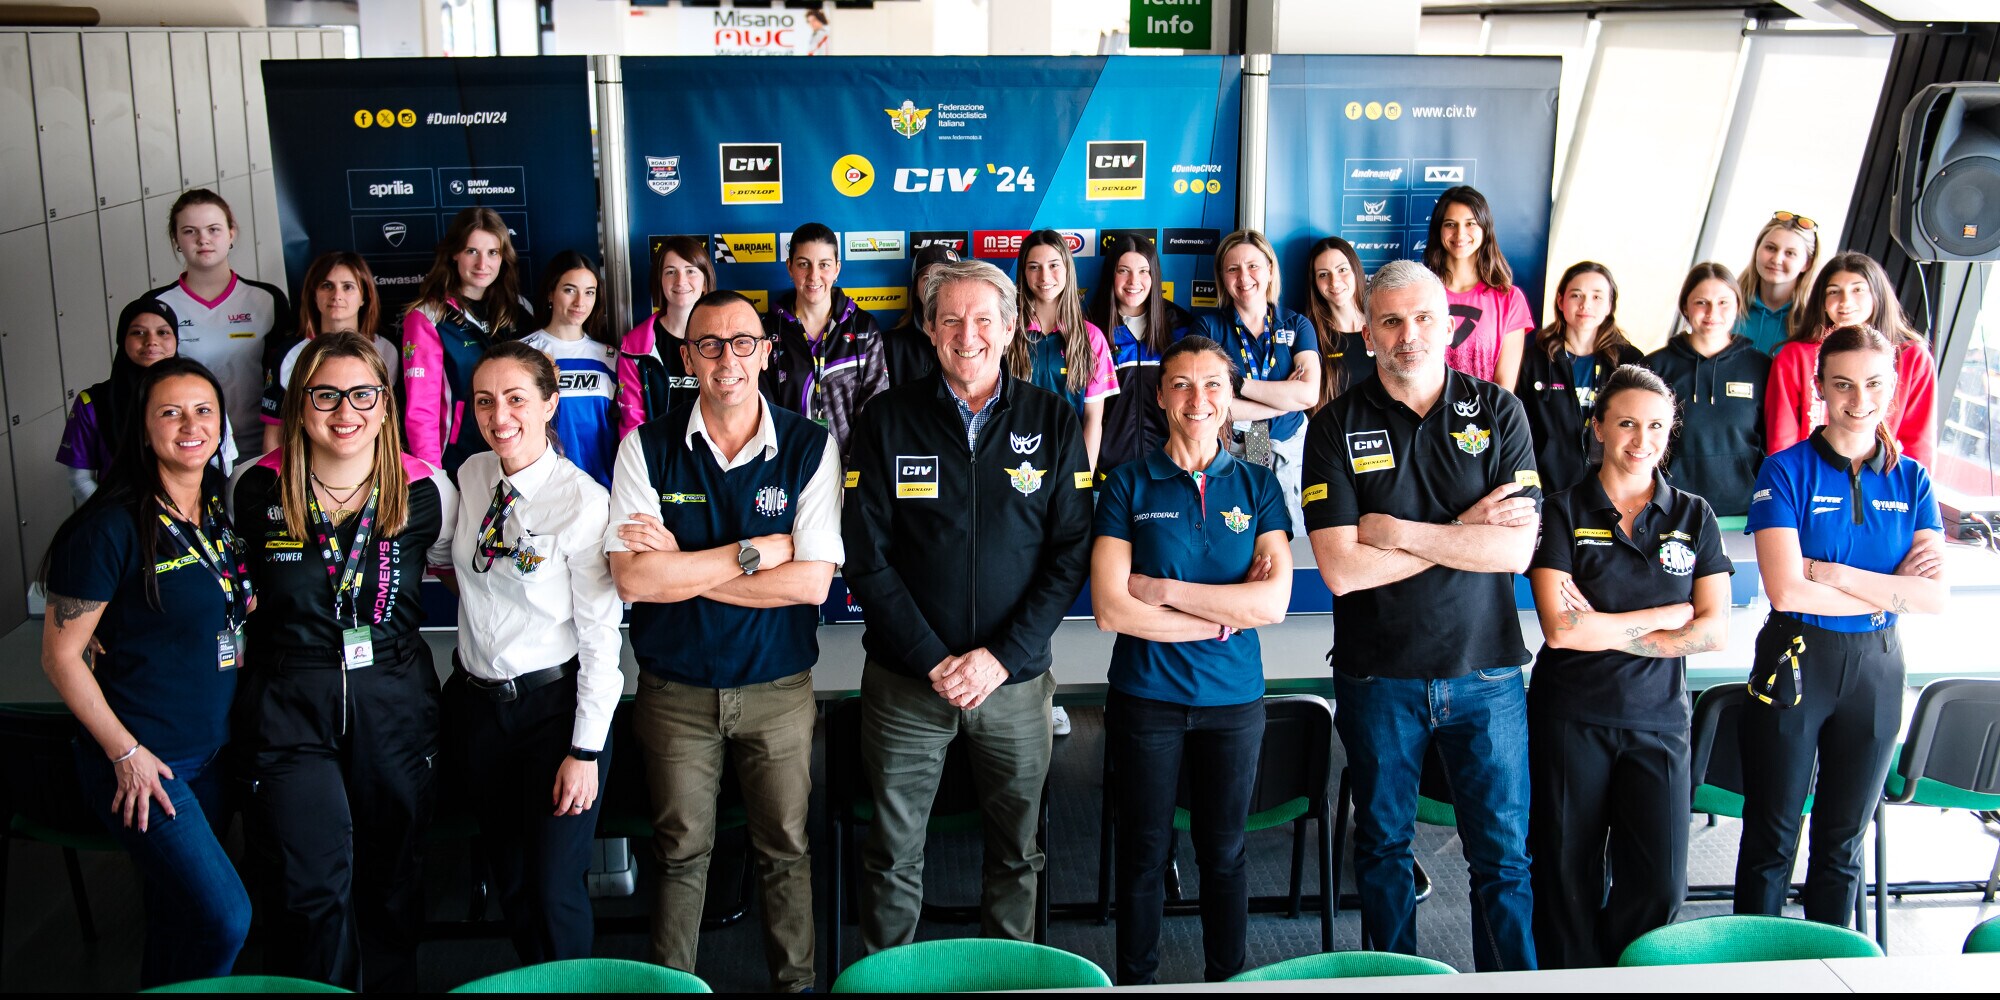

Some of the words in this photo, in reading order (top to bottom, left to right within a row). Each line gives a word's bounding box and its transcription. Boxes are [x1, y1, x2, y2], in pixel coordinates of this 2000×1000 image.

[714, 11, 794, 27] Misano
[1147, 15, 1194, 34] Info
[1412, 105, 1477, 118] www.civ.tv
[426, 112, 508, 126] #DunlopCIV24
[729, 157, 773, 171] CIV
[1095, 155, 1138, 169] CIV
[1171, 164, 1222, 174] #DunlopCIV24
[893, 167, 981, 193] CIV
[369, 180, 414, 197] aprilia
[733, 242, 773, 254] BARDAHL
[1065, 238, 1078, 247] TA
[1354, 440, 1383, 451] CIV
[902, 465, 932, 476] CIV
[392, 541, 400, 564] CUP
[374, 541, 391, 625] WOMEN'S
[384, 569, 401, 622] EUROPEAN
